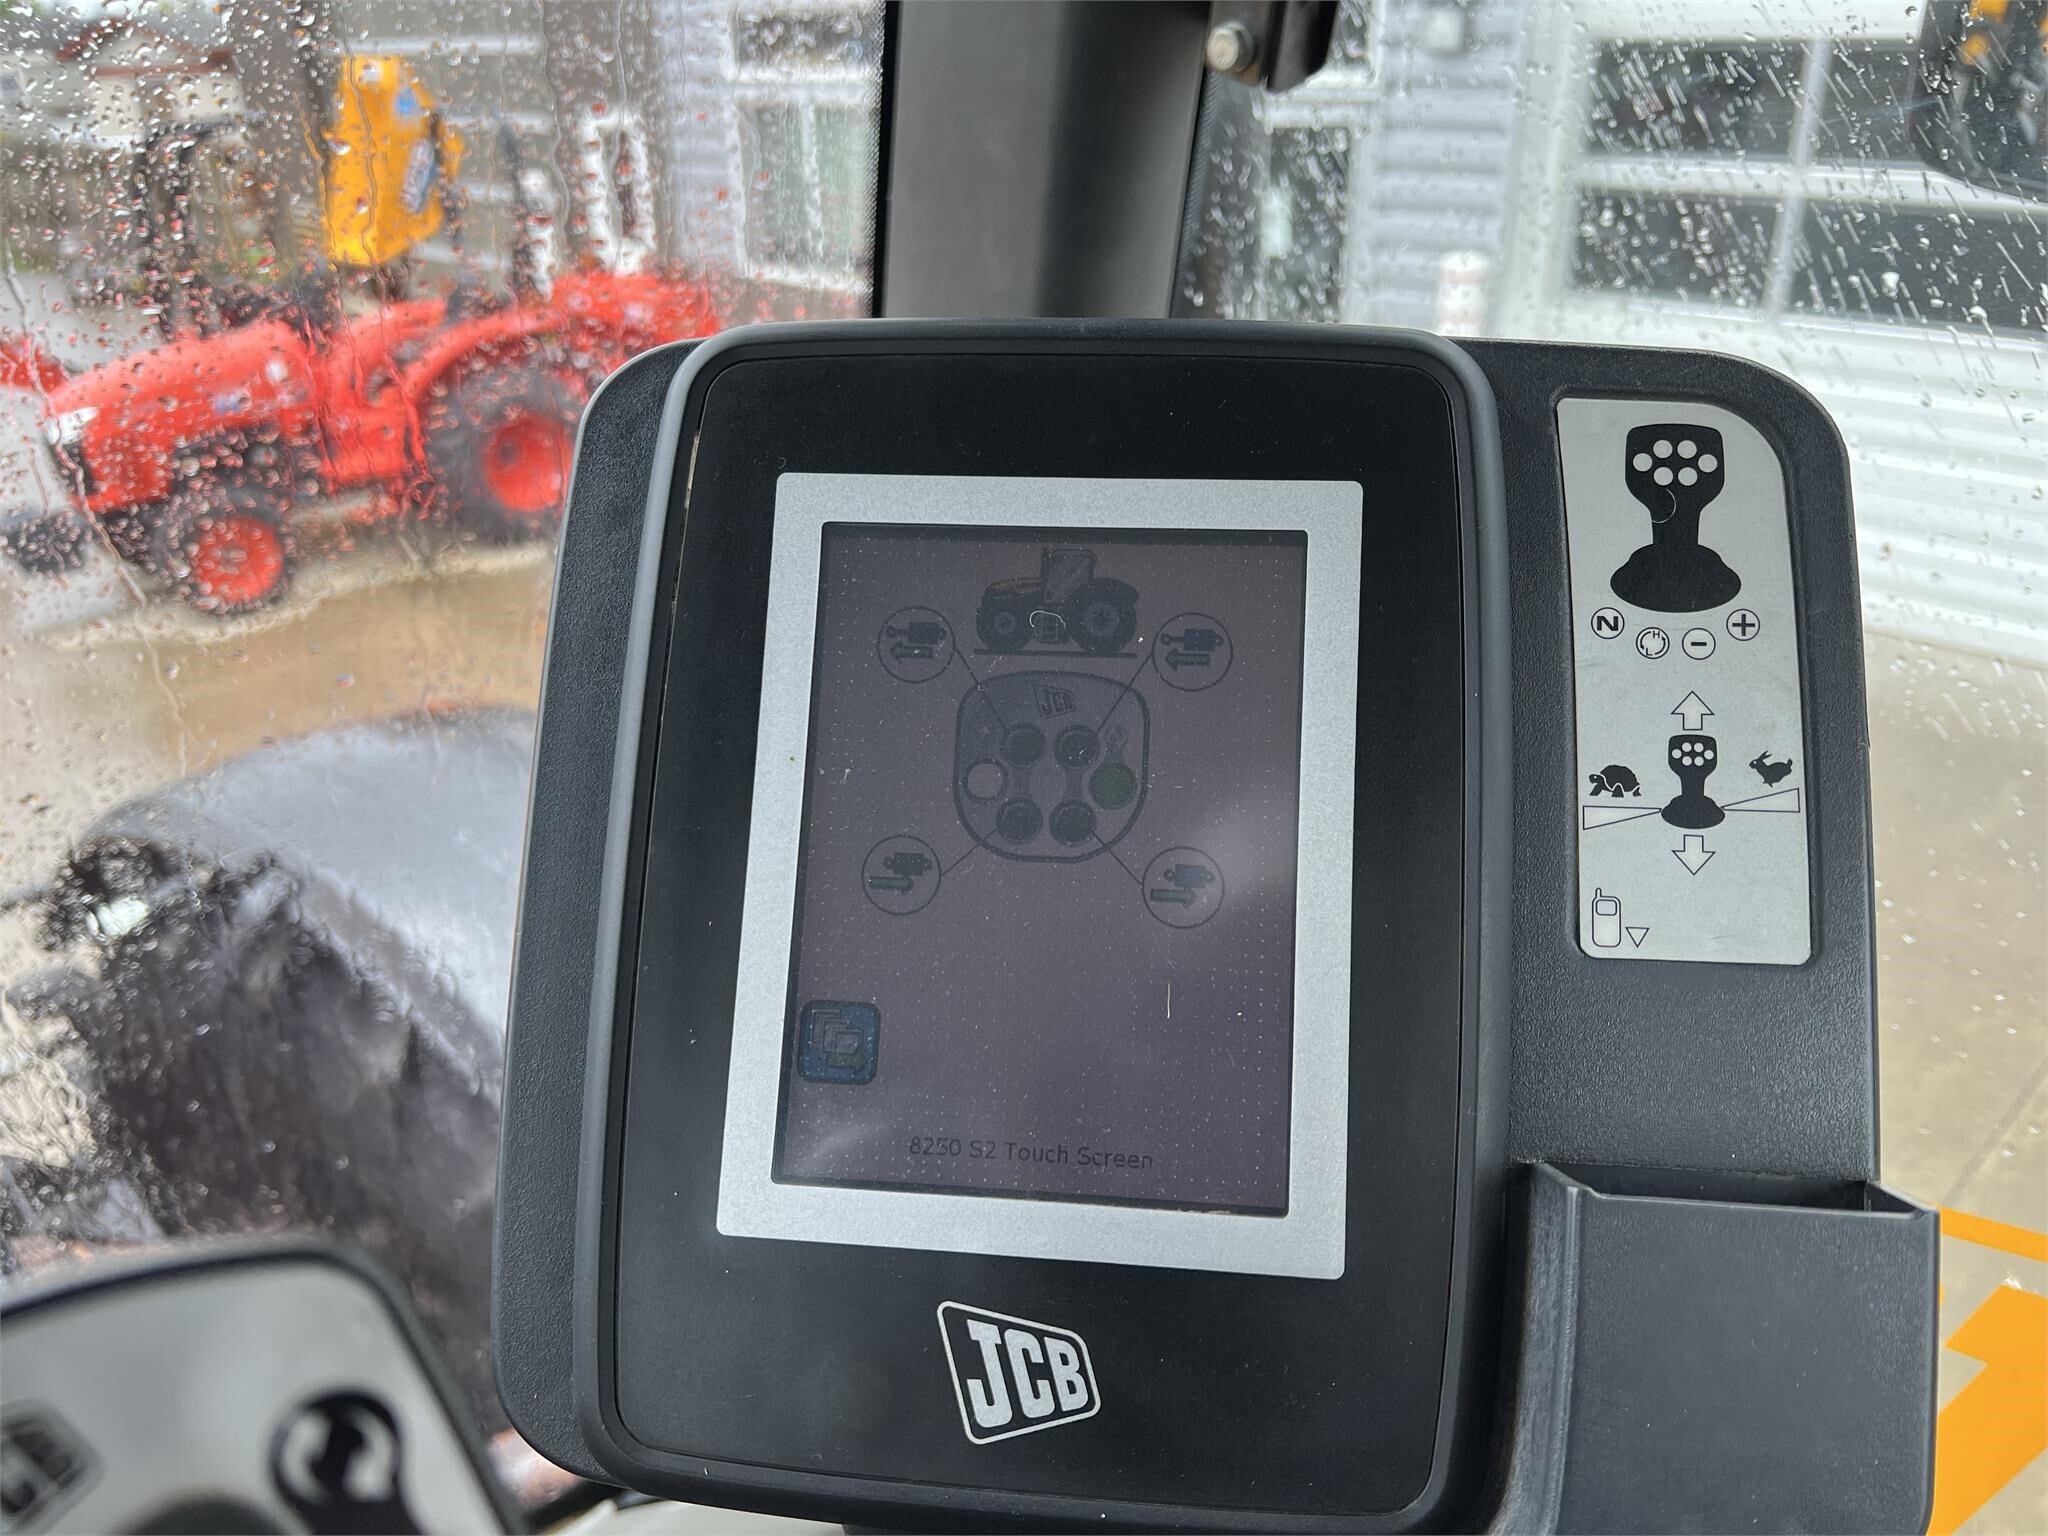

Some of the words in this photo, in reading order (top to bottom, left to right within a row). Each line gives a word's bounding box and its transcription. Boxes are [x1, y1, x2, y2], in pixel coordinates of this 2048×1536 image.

[1596, 615, 1619, 632] N
[909, 1136, 962, 1157] 8250
[968, 1139, 997, 1160] S2
[1004, 1141, 1069, 1165] Touch
[1077, 1146, 1154, 1170] Screen
[966, 1318, 1089, 1428] JCB
